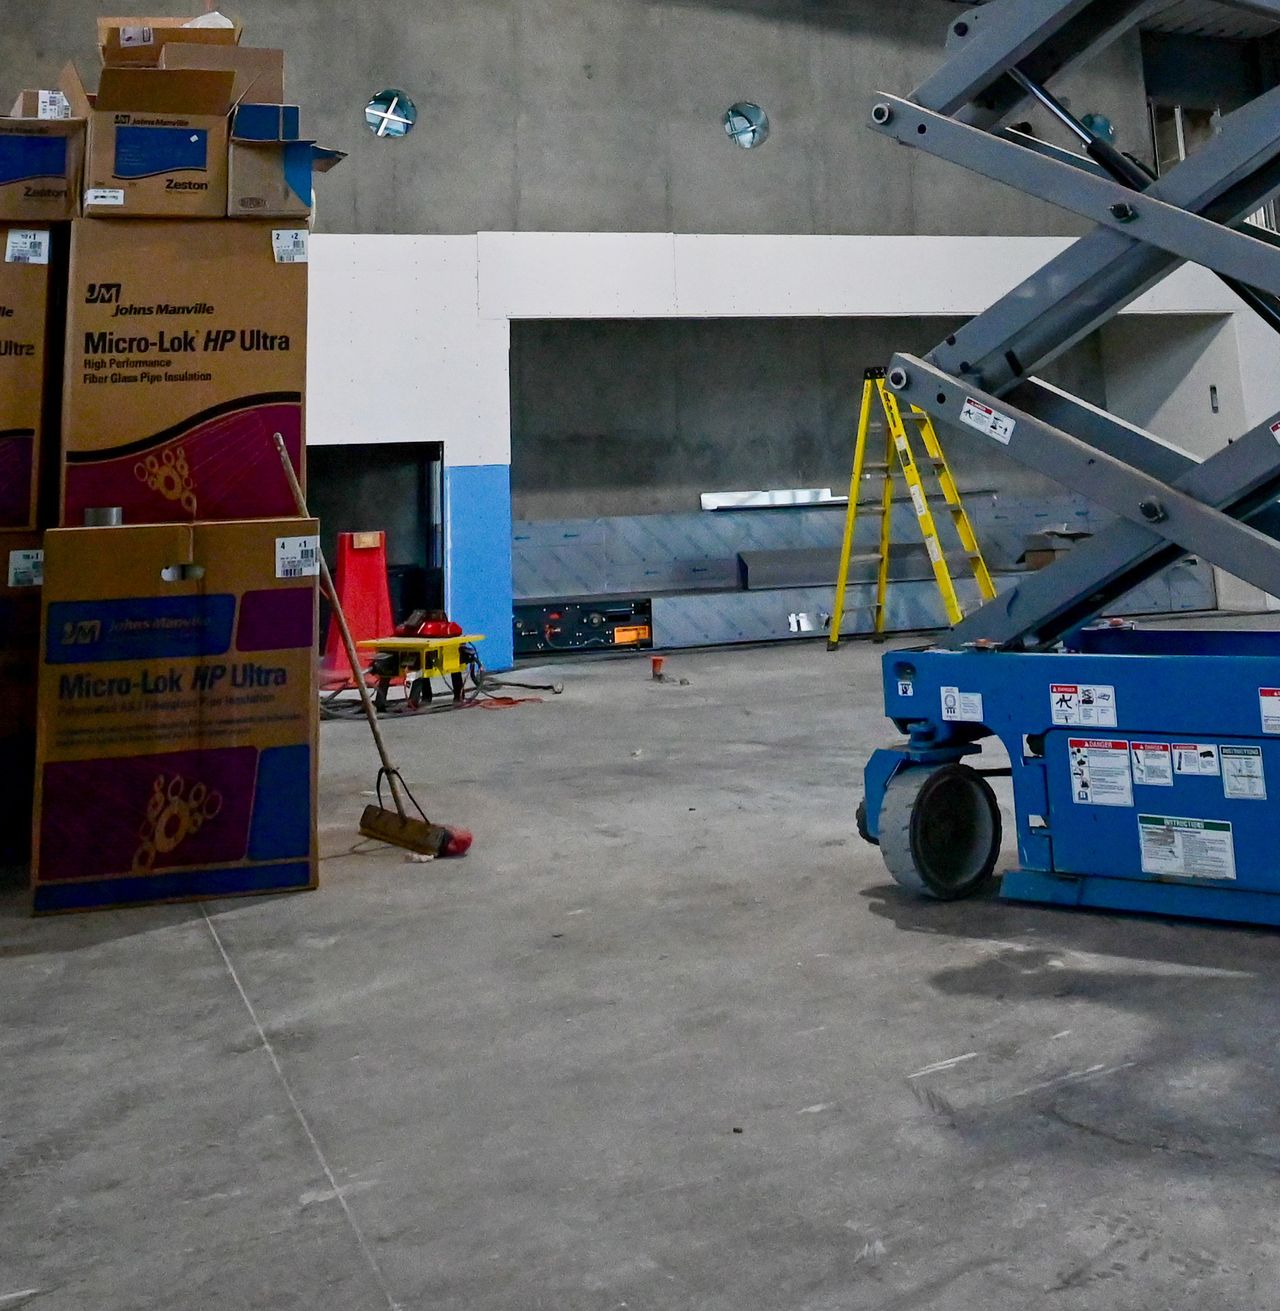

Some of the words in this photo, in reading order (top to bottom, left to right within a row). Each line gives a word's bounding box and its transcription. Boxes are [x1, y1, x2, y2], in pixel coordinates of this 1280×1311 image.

[166, 179, 208, 190] Zeston
[111, 304, 154, 318] Johns
[156, 303, 215, 315] Manville
[84, 331, 196, 354] Micro-Lok
[203, 330, 237, 352] HP
[240, 330, 290, 352] Ultra
[84, 358, 107, 370] High
[109, 358, 172, 369] Performance
[83, 373, 108, 385] Fiber
[110, 372, 138, 384] Glass
[140, 372, 162, 384] Pipe
[164, 371, 212, 383] Insulation
[59, 668, 182, 700] Micro-Lok
[191, 665, 226, 692] HP
[230, 662, 288, 688] Ultra
